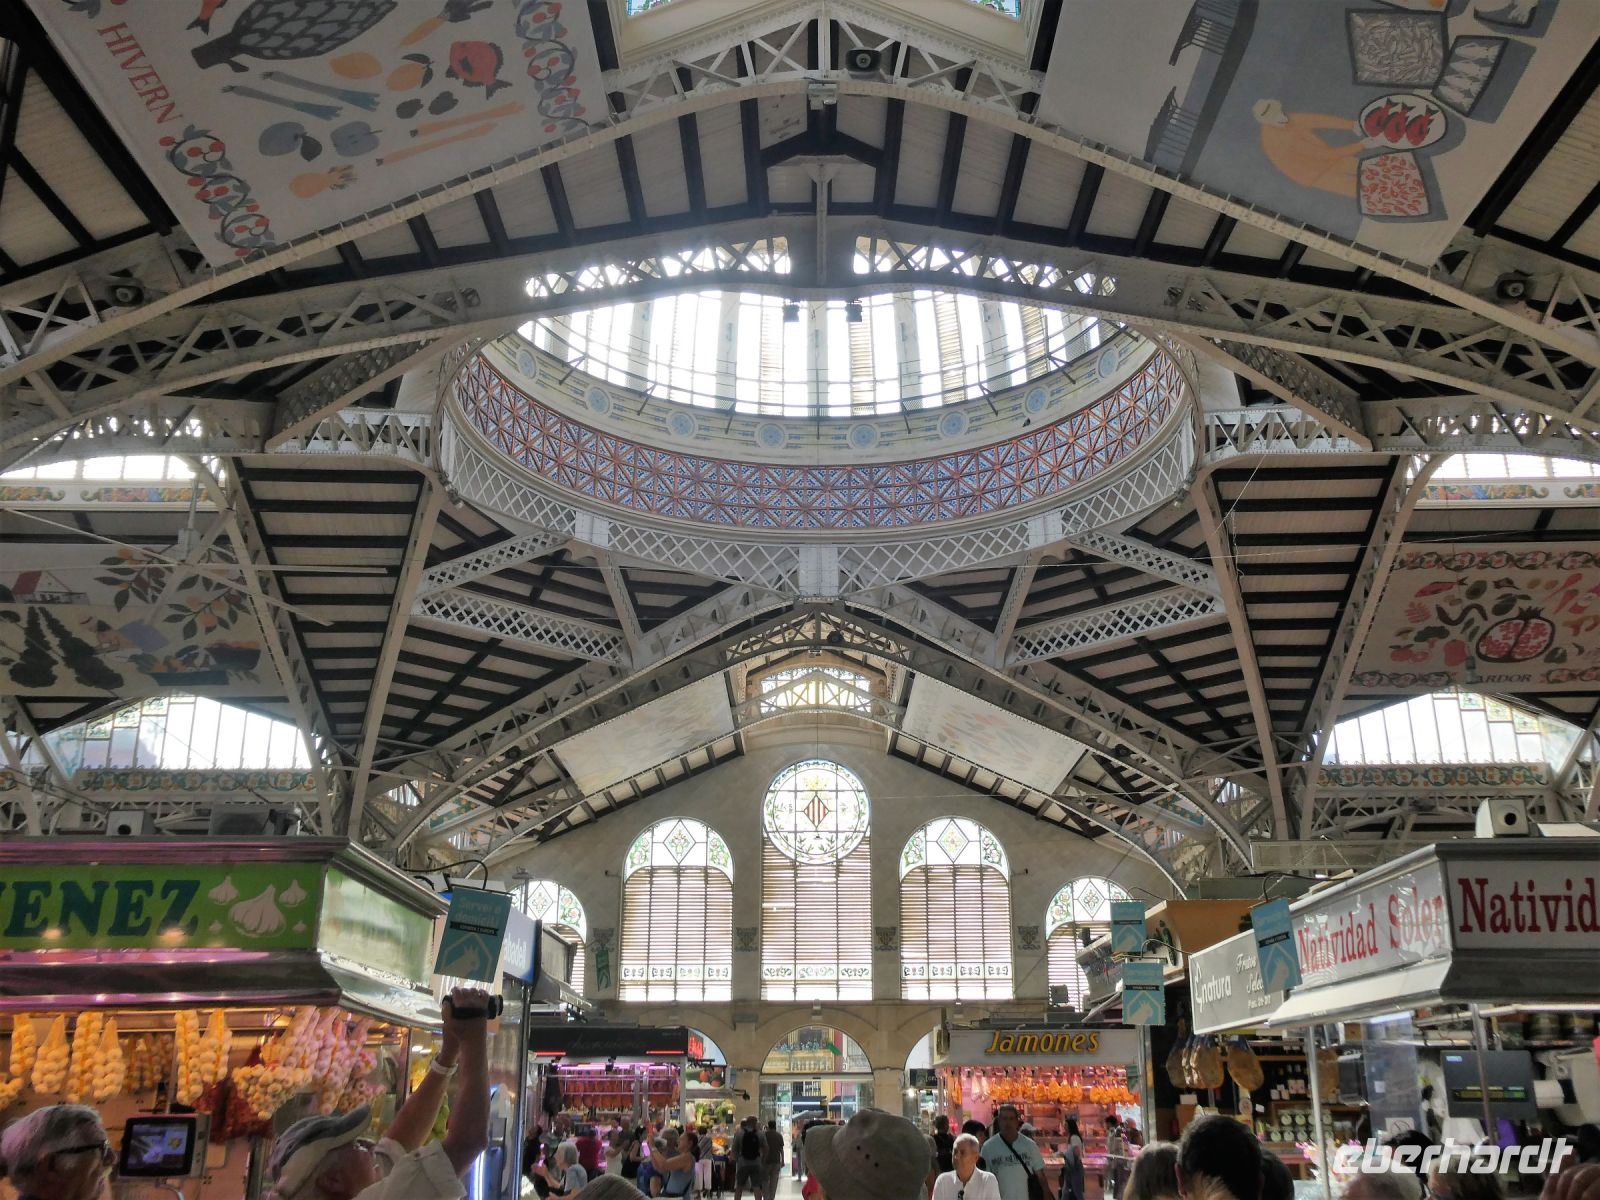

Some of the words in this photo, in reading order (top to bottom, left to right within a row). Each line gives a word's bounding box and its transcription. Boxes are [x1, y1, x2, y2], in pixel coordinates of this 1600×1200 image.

[97, 22, 184, 124] HIVERN
[1469, 673, 1532, 684] ARDOR
[0, 880, 200, 937] ENEZ
[1297, 903, 1378, 975] Natividad
[1388, 885, 1447, 950] Soler
[1458, 878, 1600, 934] Nativid
[503, 932, 527, 968] abadell
[985, 1030, 1100, 1054] Jamones
